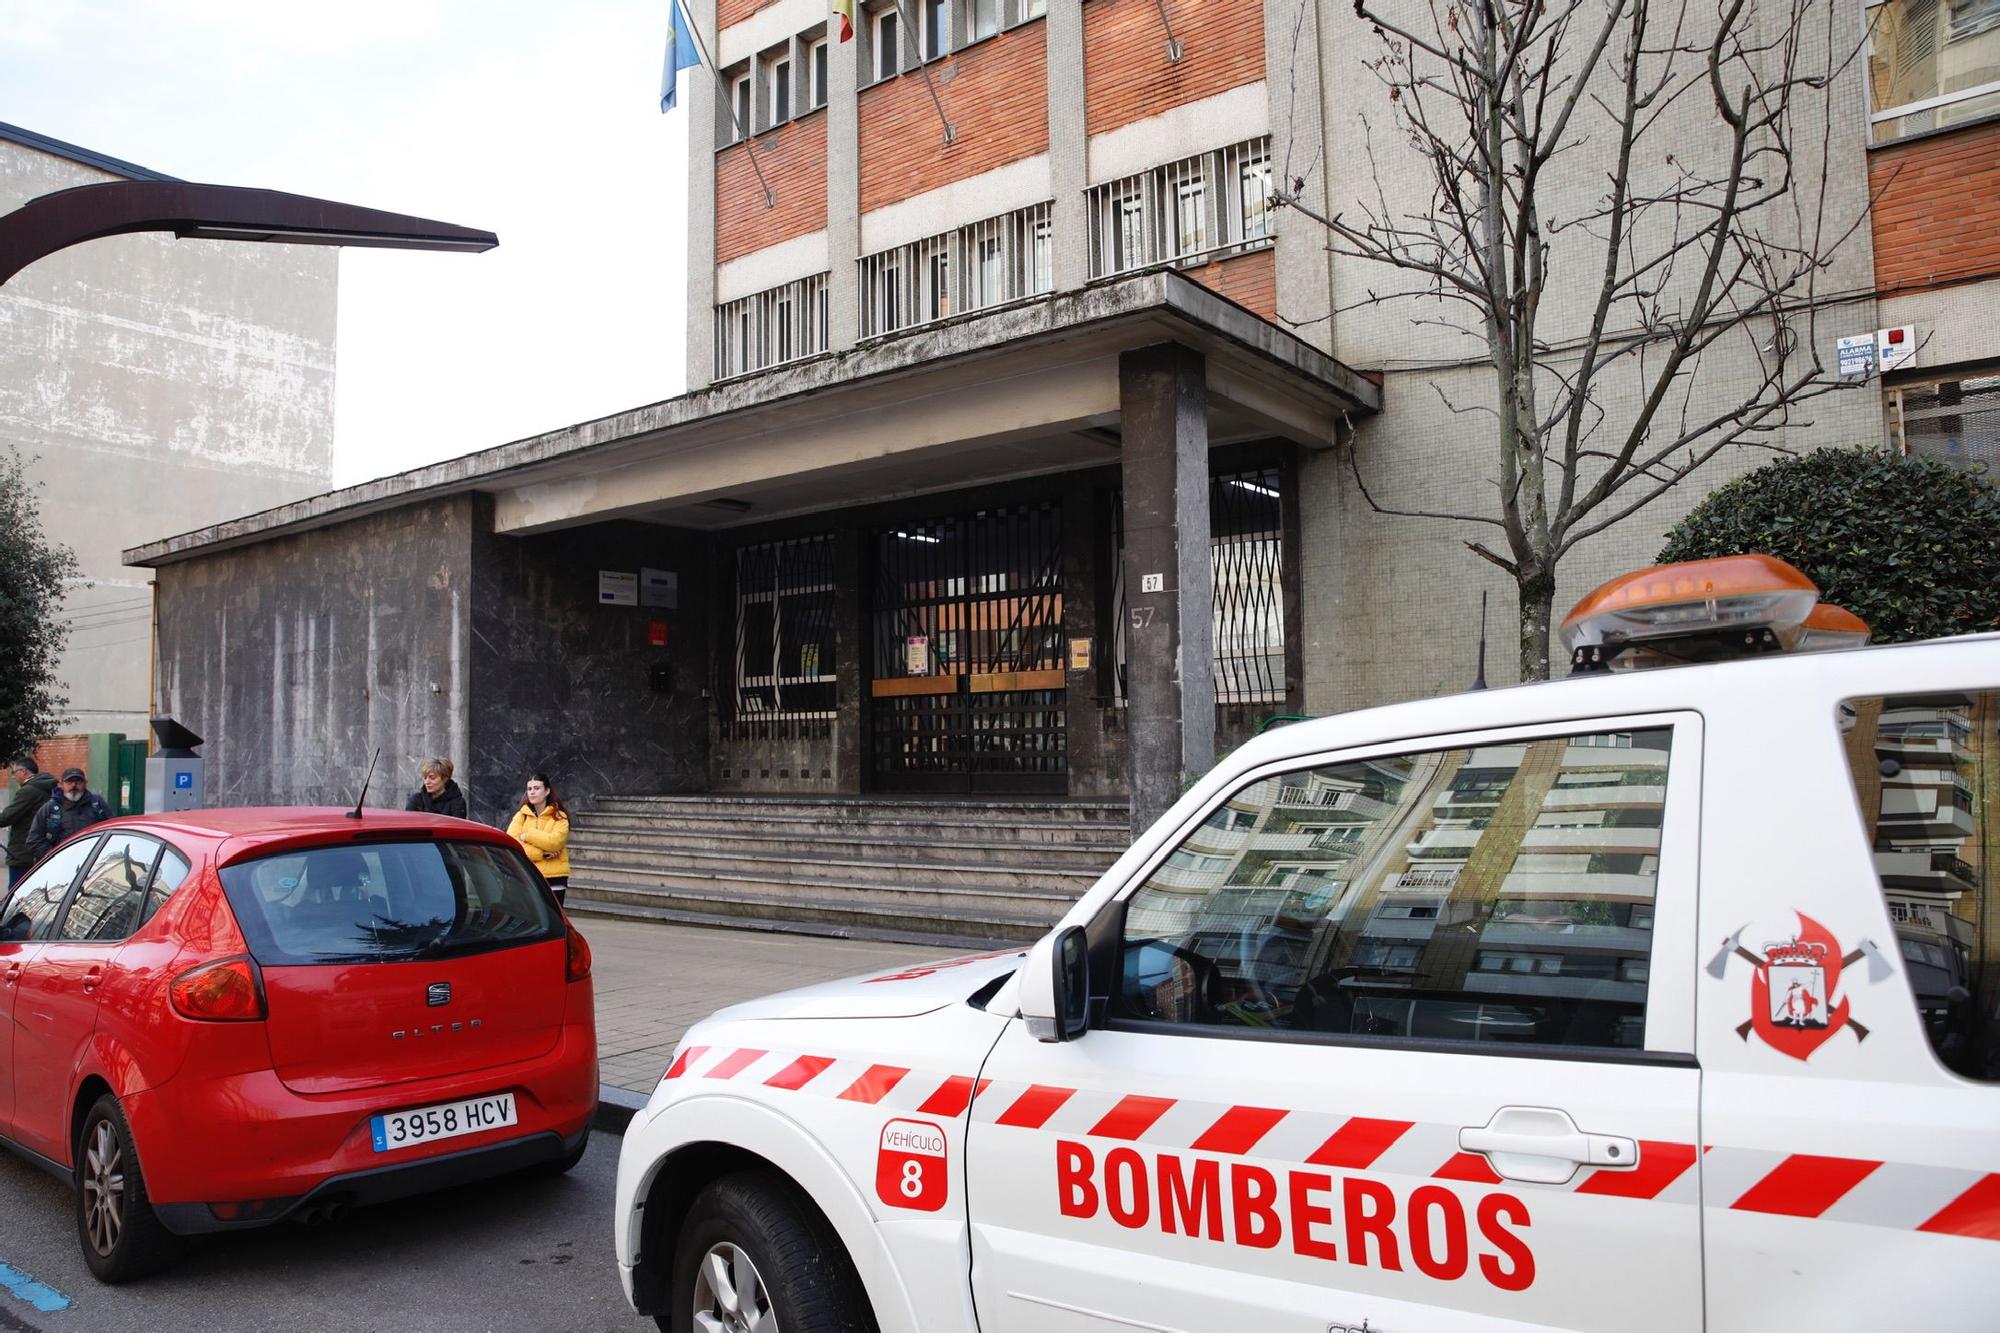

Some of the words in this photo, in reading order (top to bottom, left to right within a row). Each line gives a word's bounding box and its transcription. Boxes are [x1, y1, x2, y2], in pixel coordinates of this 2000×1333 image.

[1840, 345, 1872, 355] ALARMA
[1146, 576, 1158, 590] 57
[1131, 606, 1154, 628] 57
[179, 775, 189, 786] P
[391, 1108, 459, 1142] 3958
[465, 1098, 509, 1129] HCV
[886, 1130, 943, 1152] VEHÍCULO
[900, 1159, 923, 1198] 8
[1055, 1138, 1537, 1292] BOMBEROS
